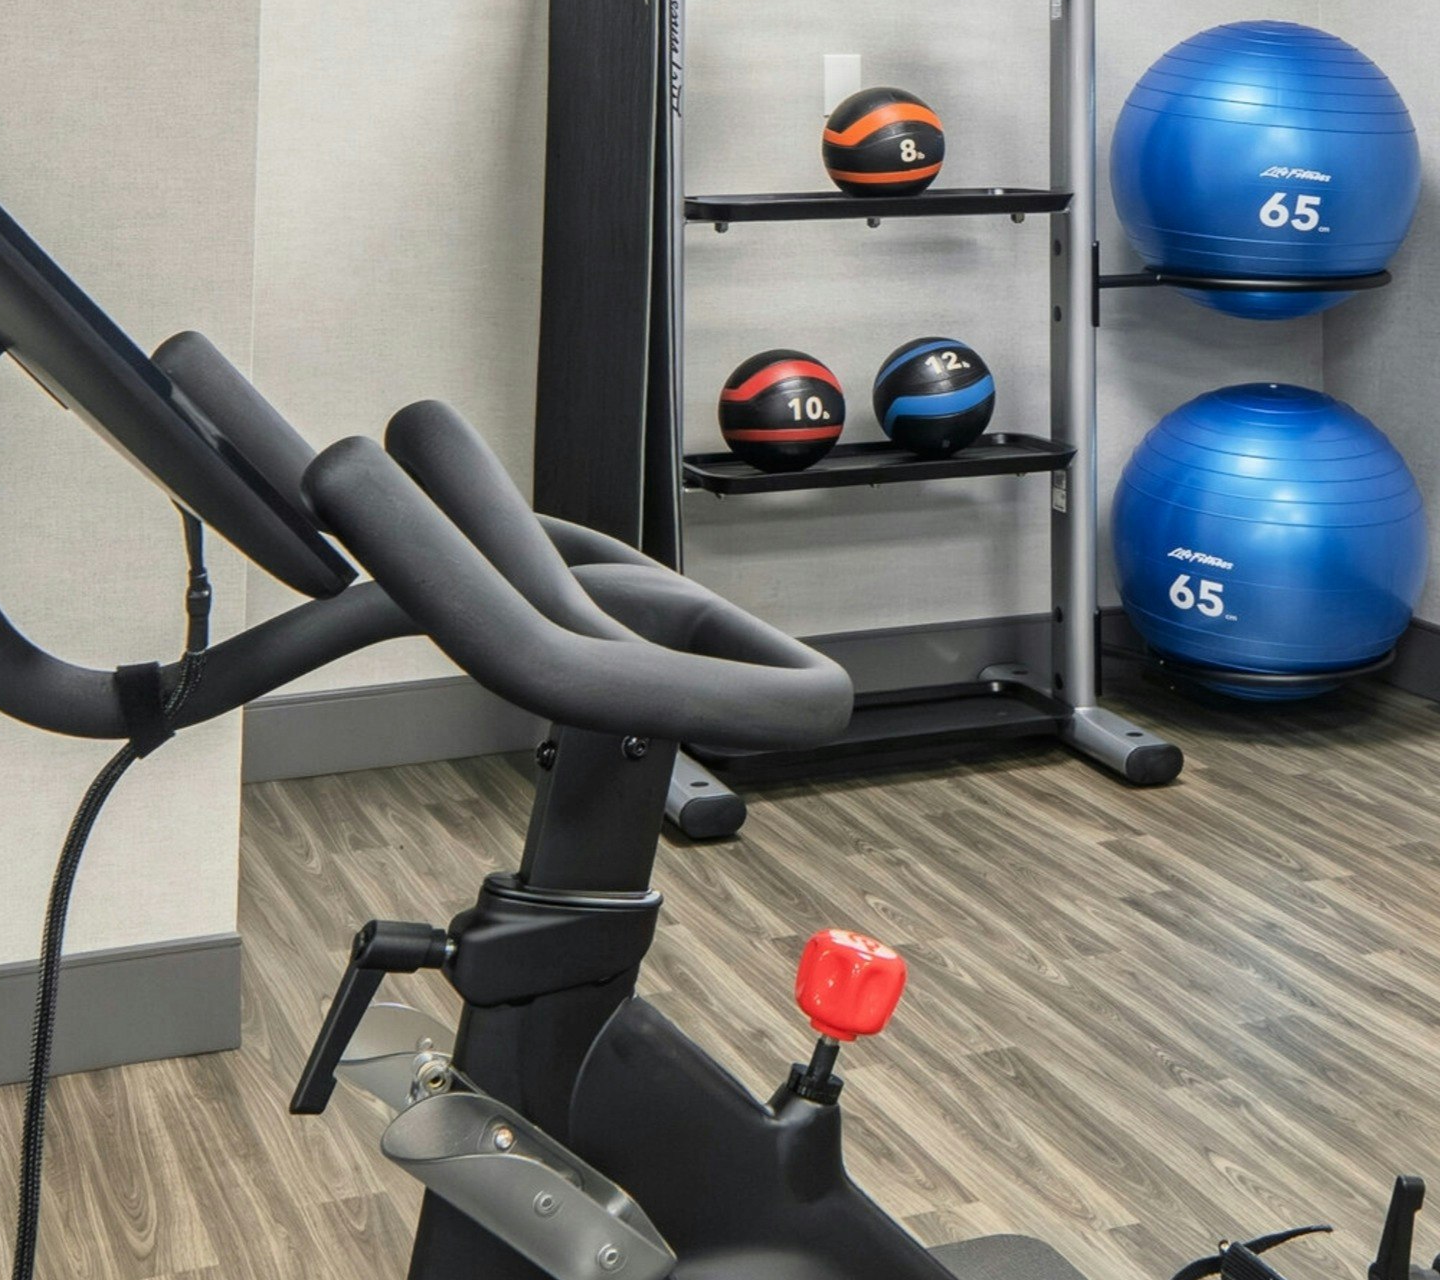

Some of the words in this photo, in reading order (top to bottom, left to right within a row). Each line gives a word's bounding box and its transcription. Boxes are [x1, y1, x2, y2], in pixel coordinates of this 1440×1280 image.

[899, 139, 917, 162] 8
[1259, 192, 1321, 231] 65
[925, 351, 962, 375] 12
[787, 396, 823, 421] 10
[1169, 574, 1224, 617] 65
